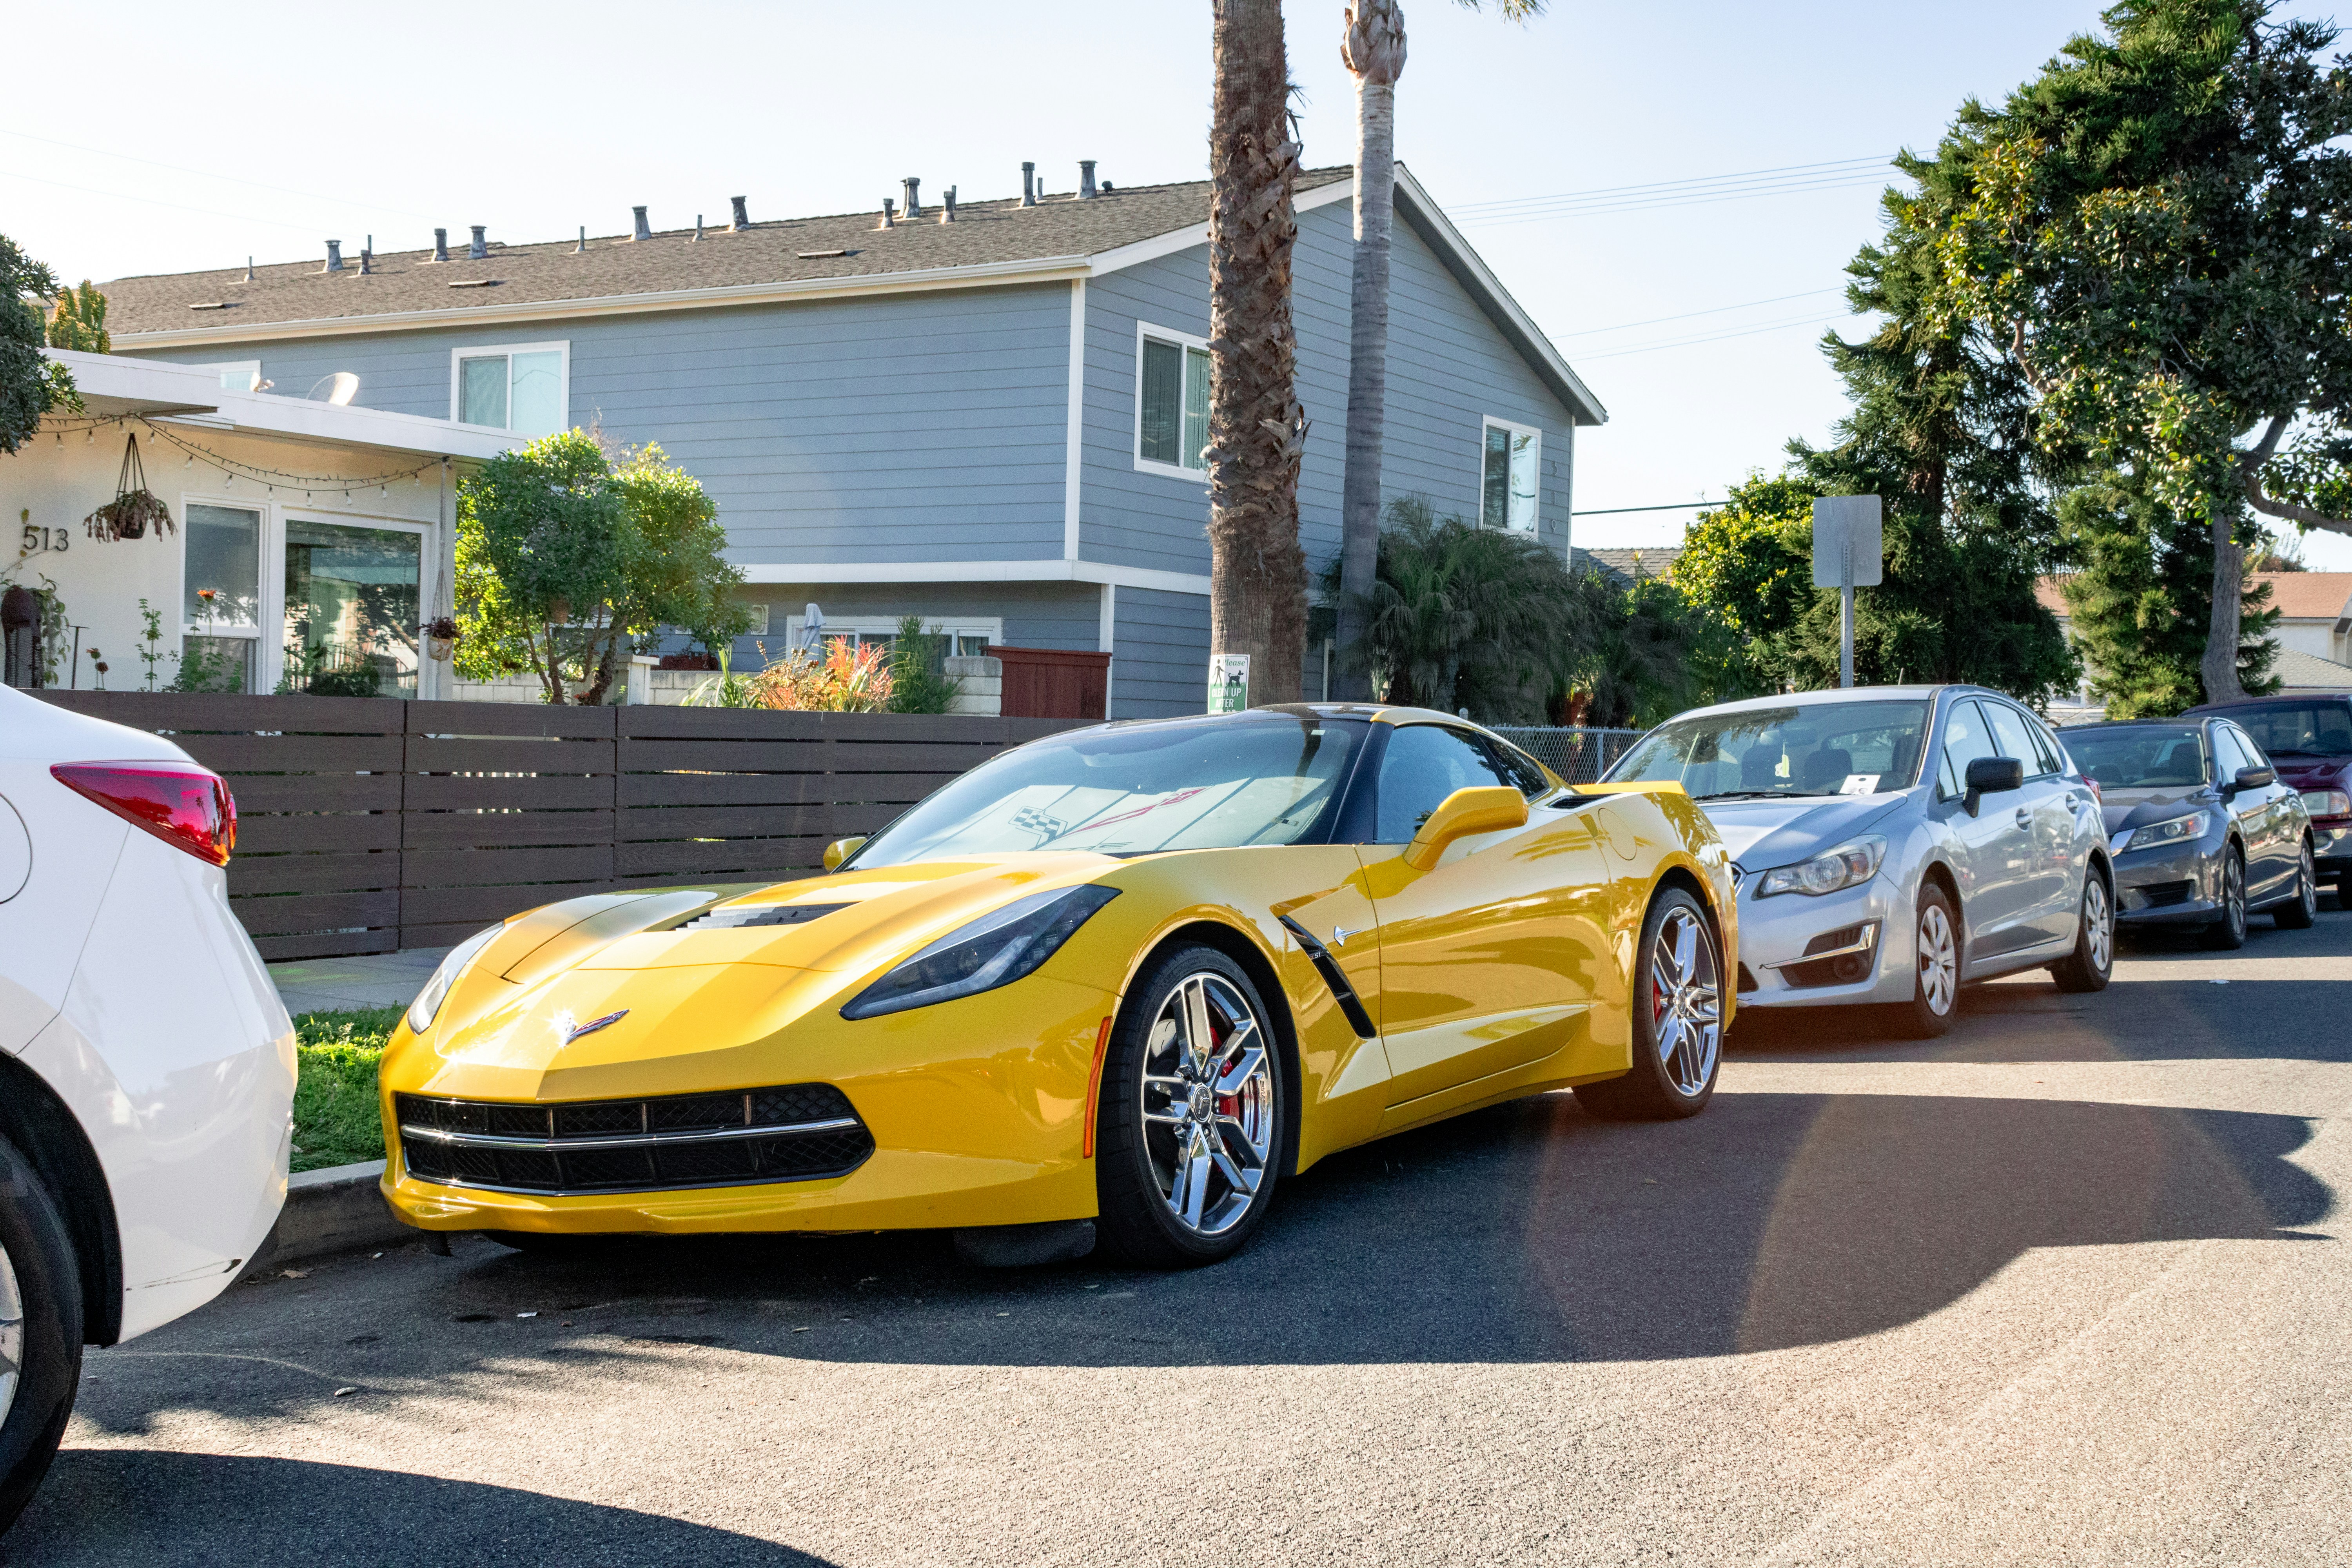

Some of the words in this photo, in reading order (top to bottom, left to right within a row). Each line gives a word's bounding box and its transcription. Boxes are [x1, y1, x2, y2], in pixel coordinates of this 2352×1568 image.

[24, 526, 68, 551] 513
[1212, 688, 1229, 698] CLEAN
[1231, 688, 1242, 697] UP
[1215, 699, 1234, 708] AFTER
